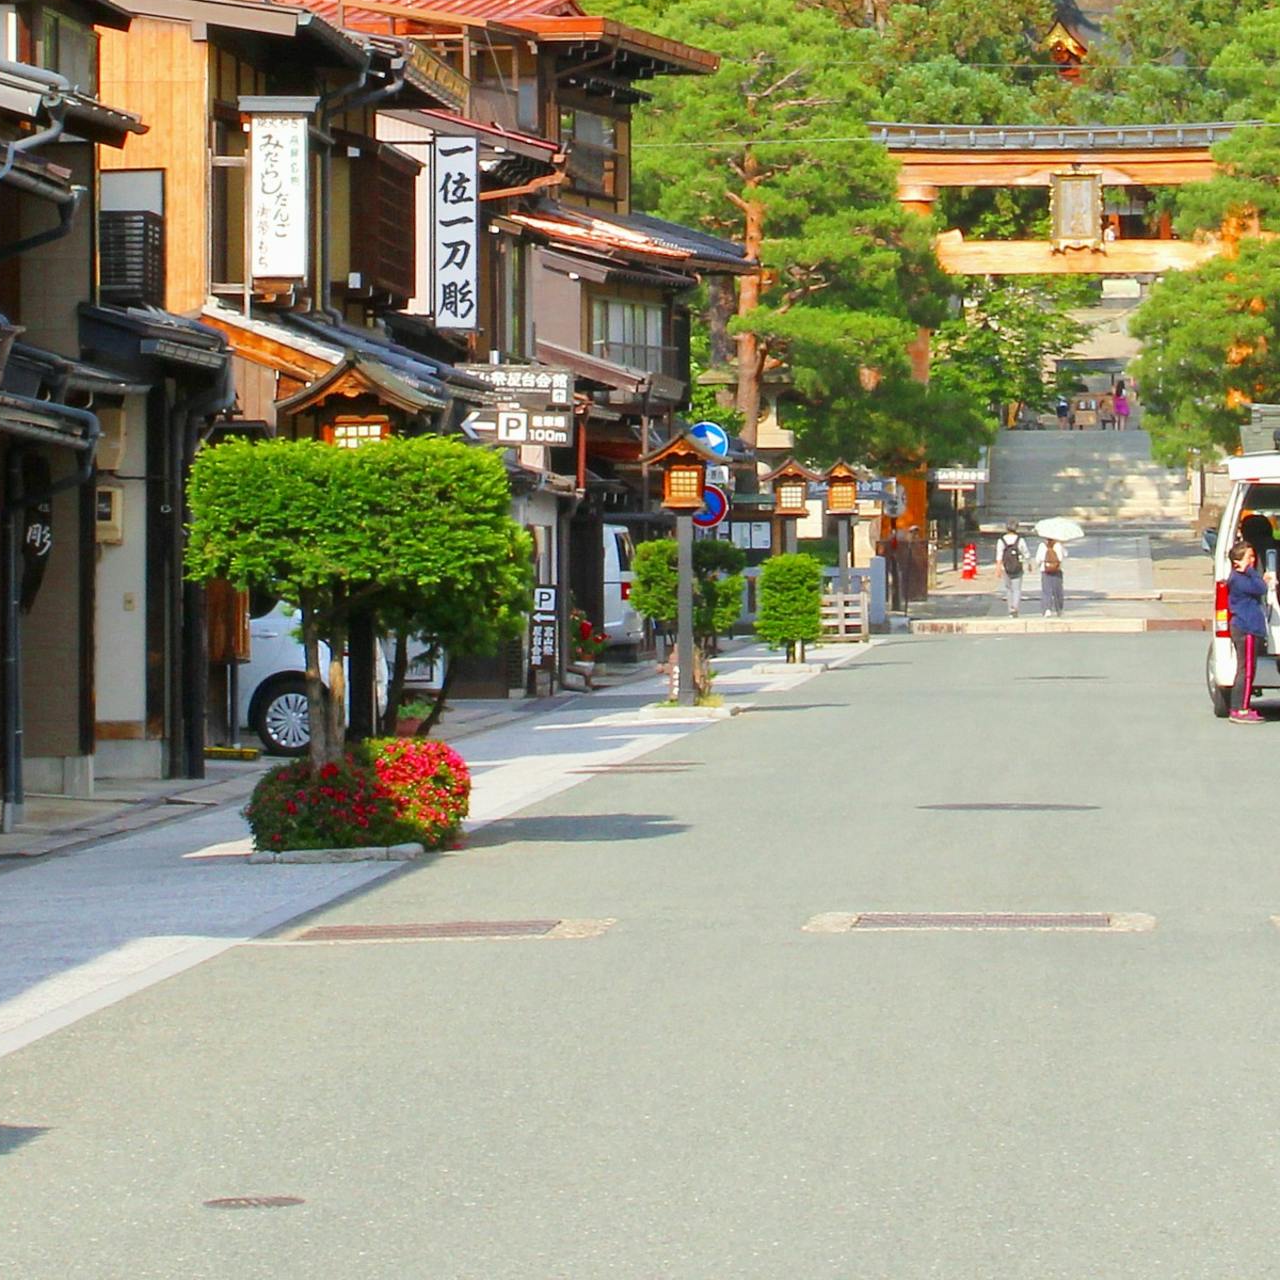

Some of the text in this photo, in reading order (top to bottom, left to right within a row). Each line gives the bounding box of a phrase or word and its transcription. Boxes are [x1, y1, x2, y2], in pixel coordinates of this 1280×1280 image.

[438, 144, 475, 319] 一位一刀彫
[506, 418, 522, 438] P
[529, 429, 567, 442] 100m
[540, 592, 552, 608] P
